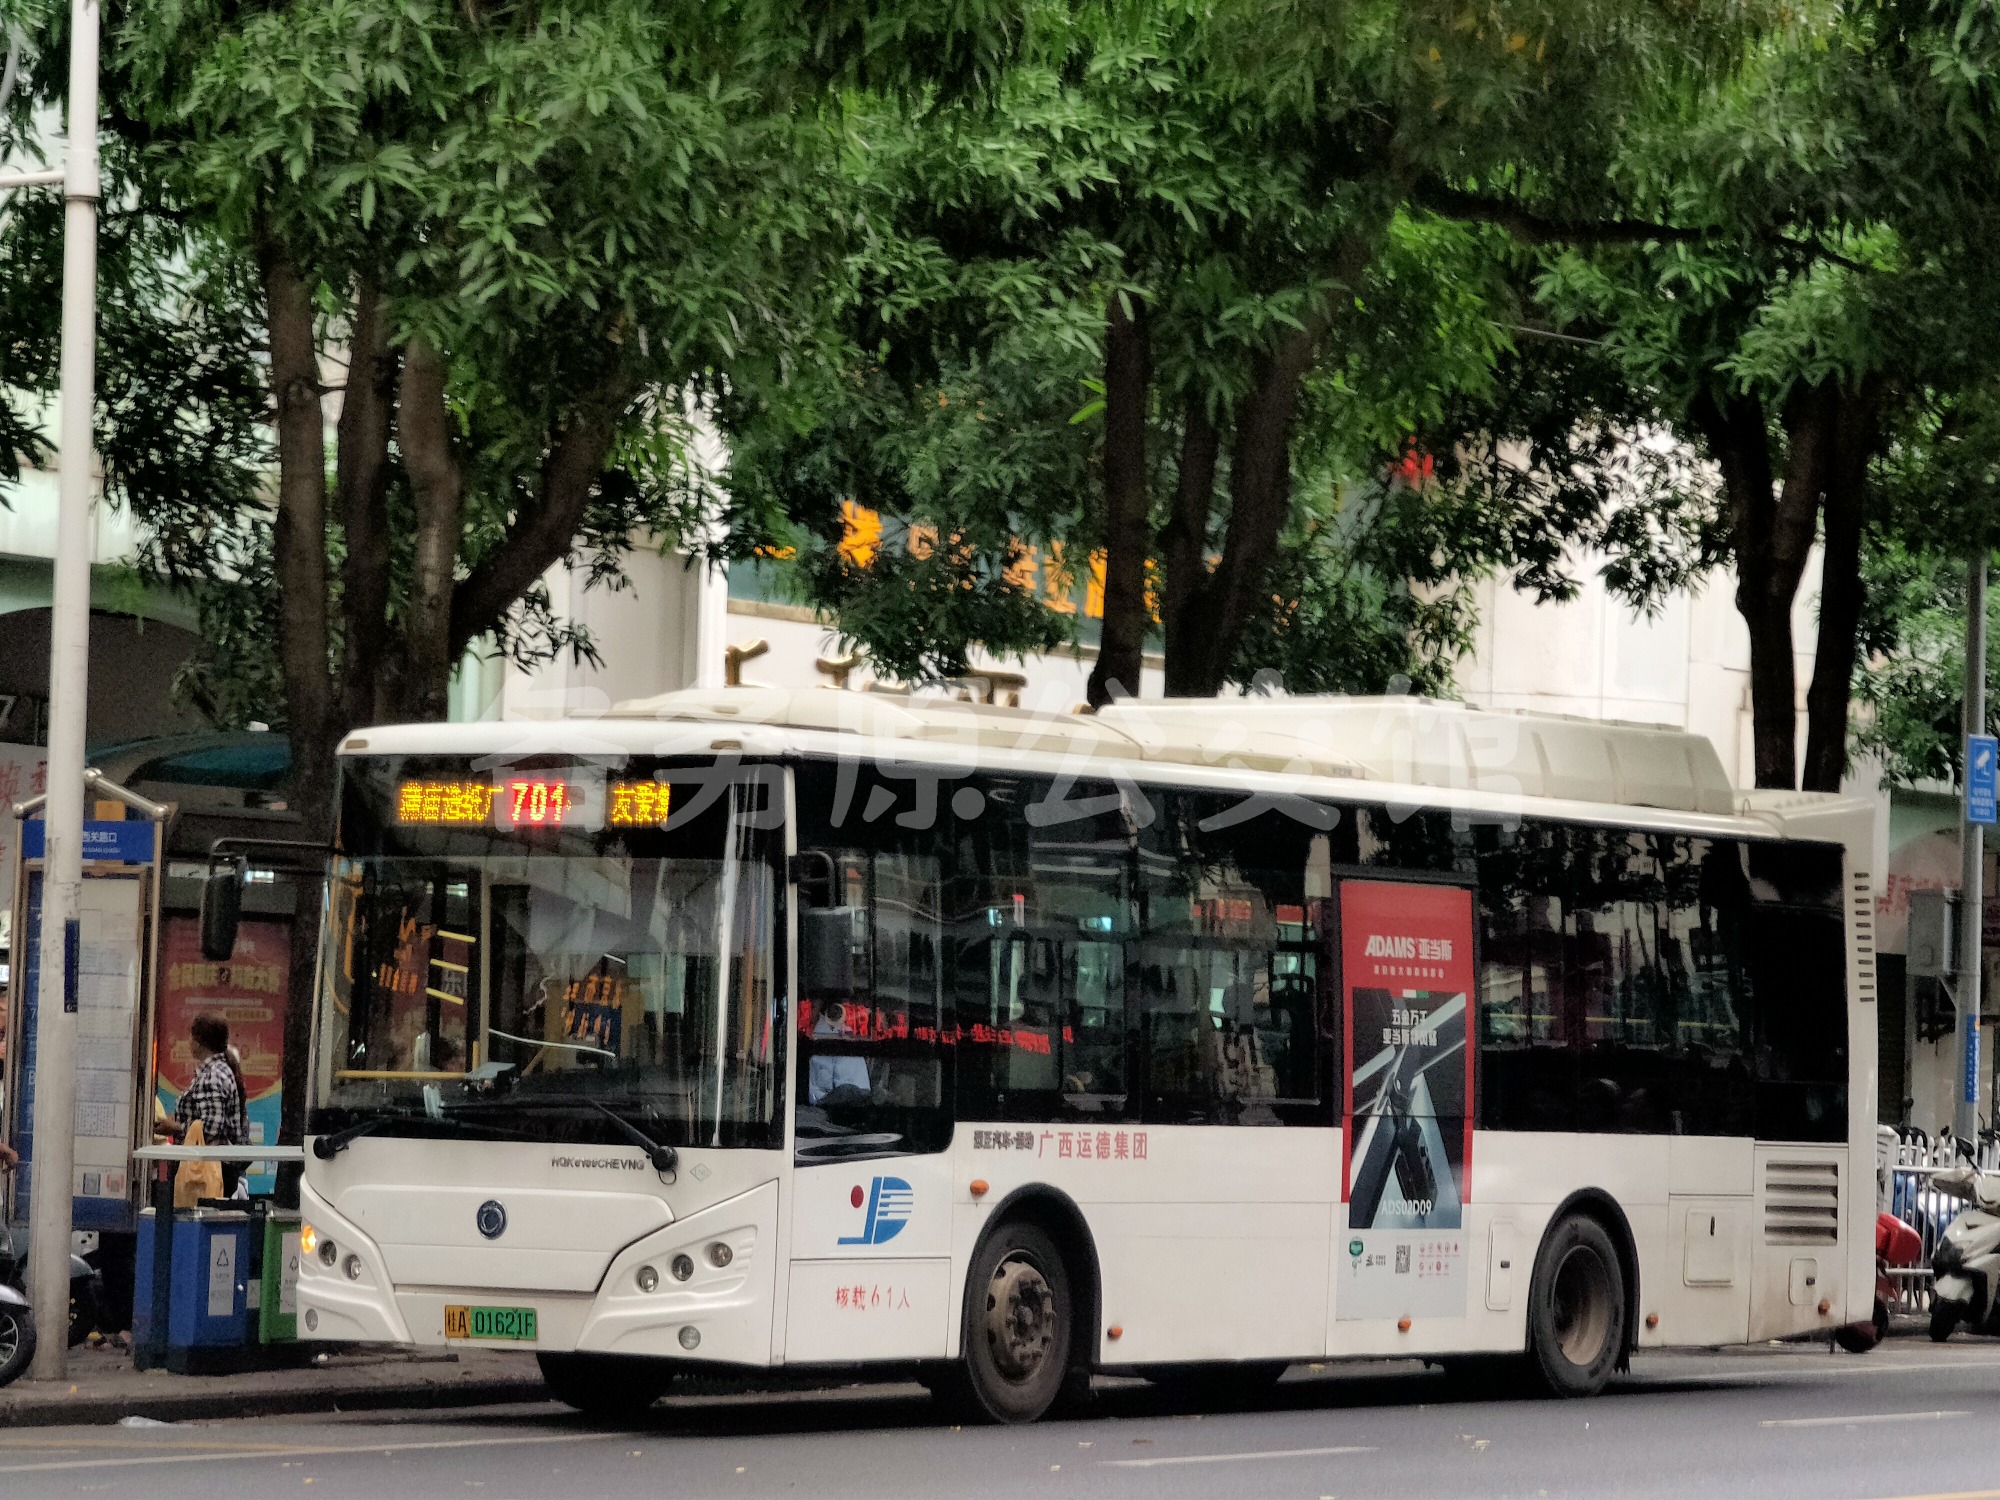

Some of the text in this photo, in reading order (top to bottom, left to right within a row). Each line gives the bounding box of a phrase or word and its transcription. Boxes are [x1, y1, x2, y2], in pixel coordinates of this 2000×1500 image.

[510, 782, 564, 822] 701
[1365, 935, 1453, 961] ADAMS 亚当斯
[1038, 1130, 1148, 1160] 广西运德集团
